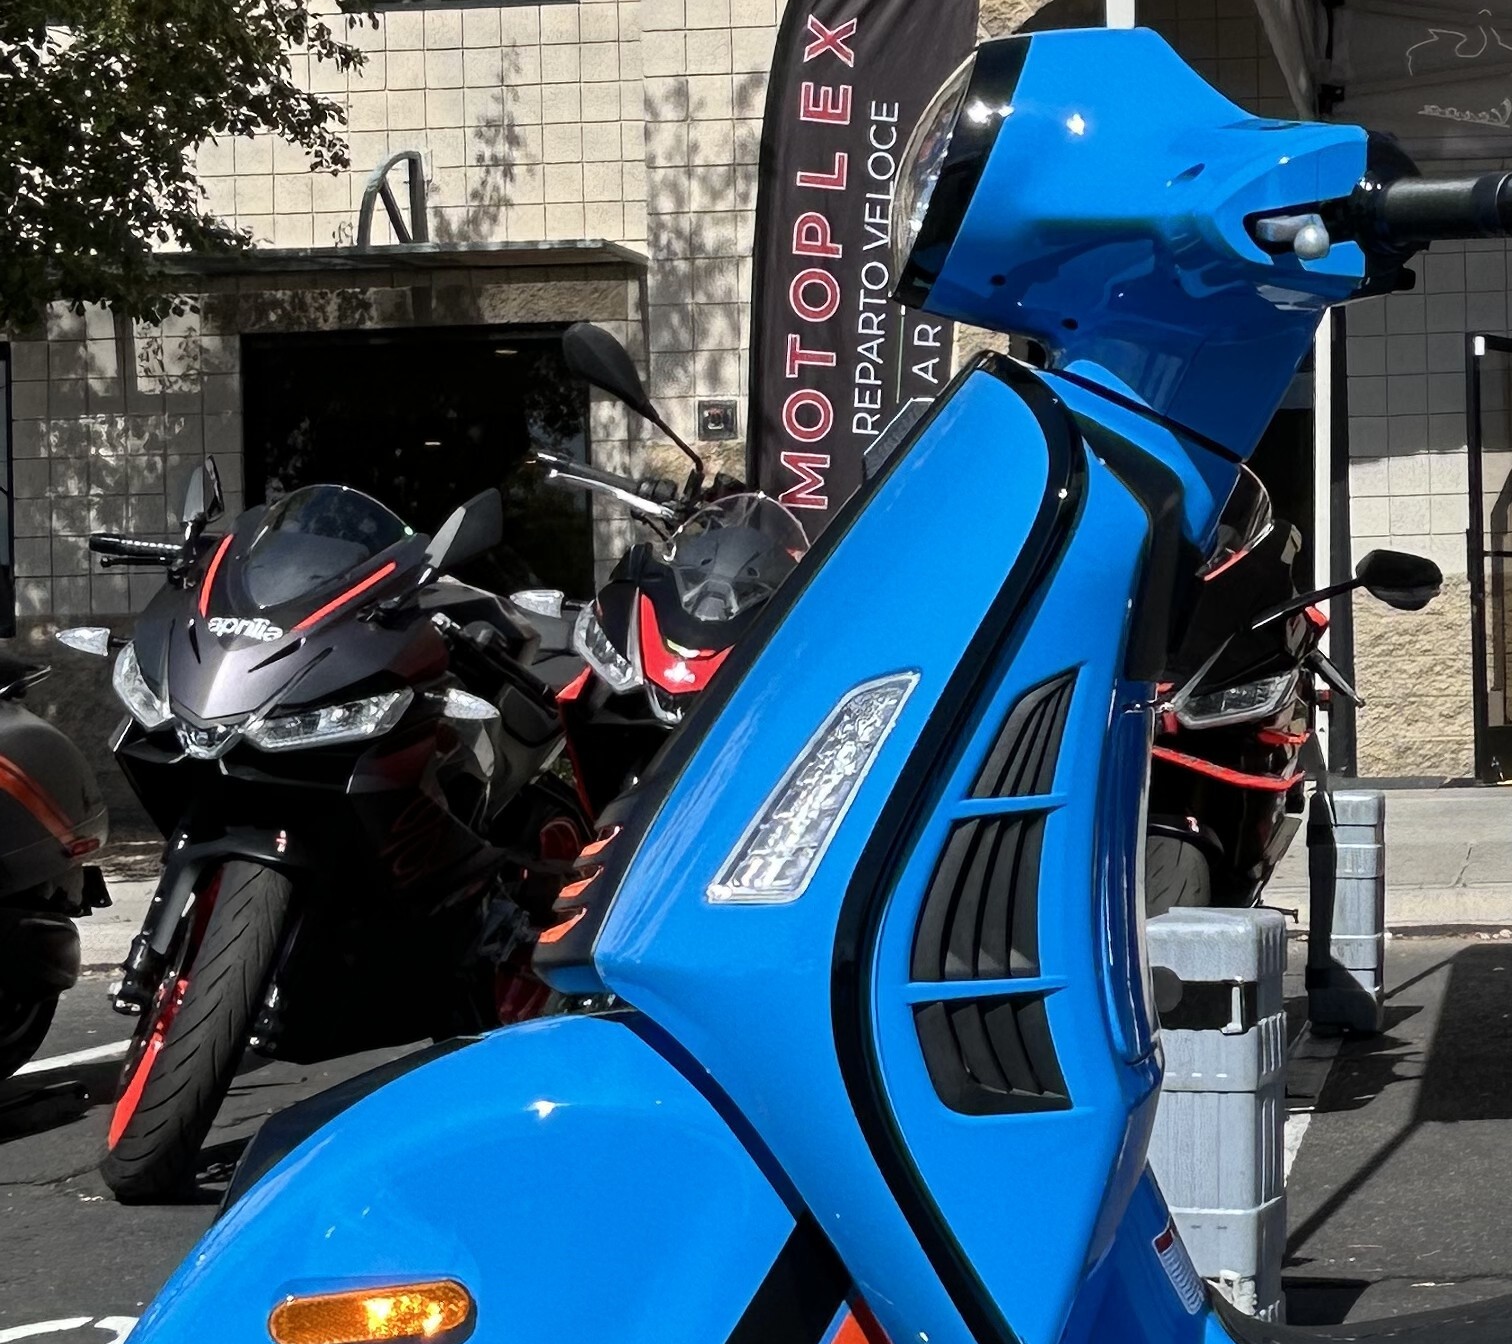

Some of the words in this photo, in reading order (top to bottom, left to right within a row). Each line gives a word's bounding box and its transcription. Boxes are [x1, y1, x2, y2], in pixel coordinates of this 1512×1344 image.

[862, 100, 900, 251] VELOCE
[777, 13, 858, 511] MOTOPLEX
[851, 260, 890, 435] REPARTO
[207, 616, 284, 642] aprilia
